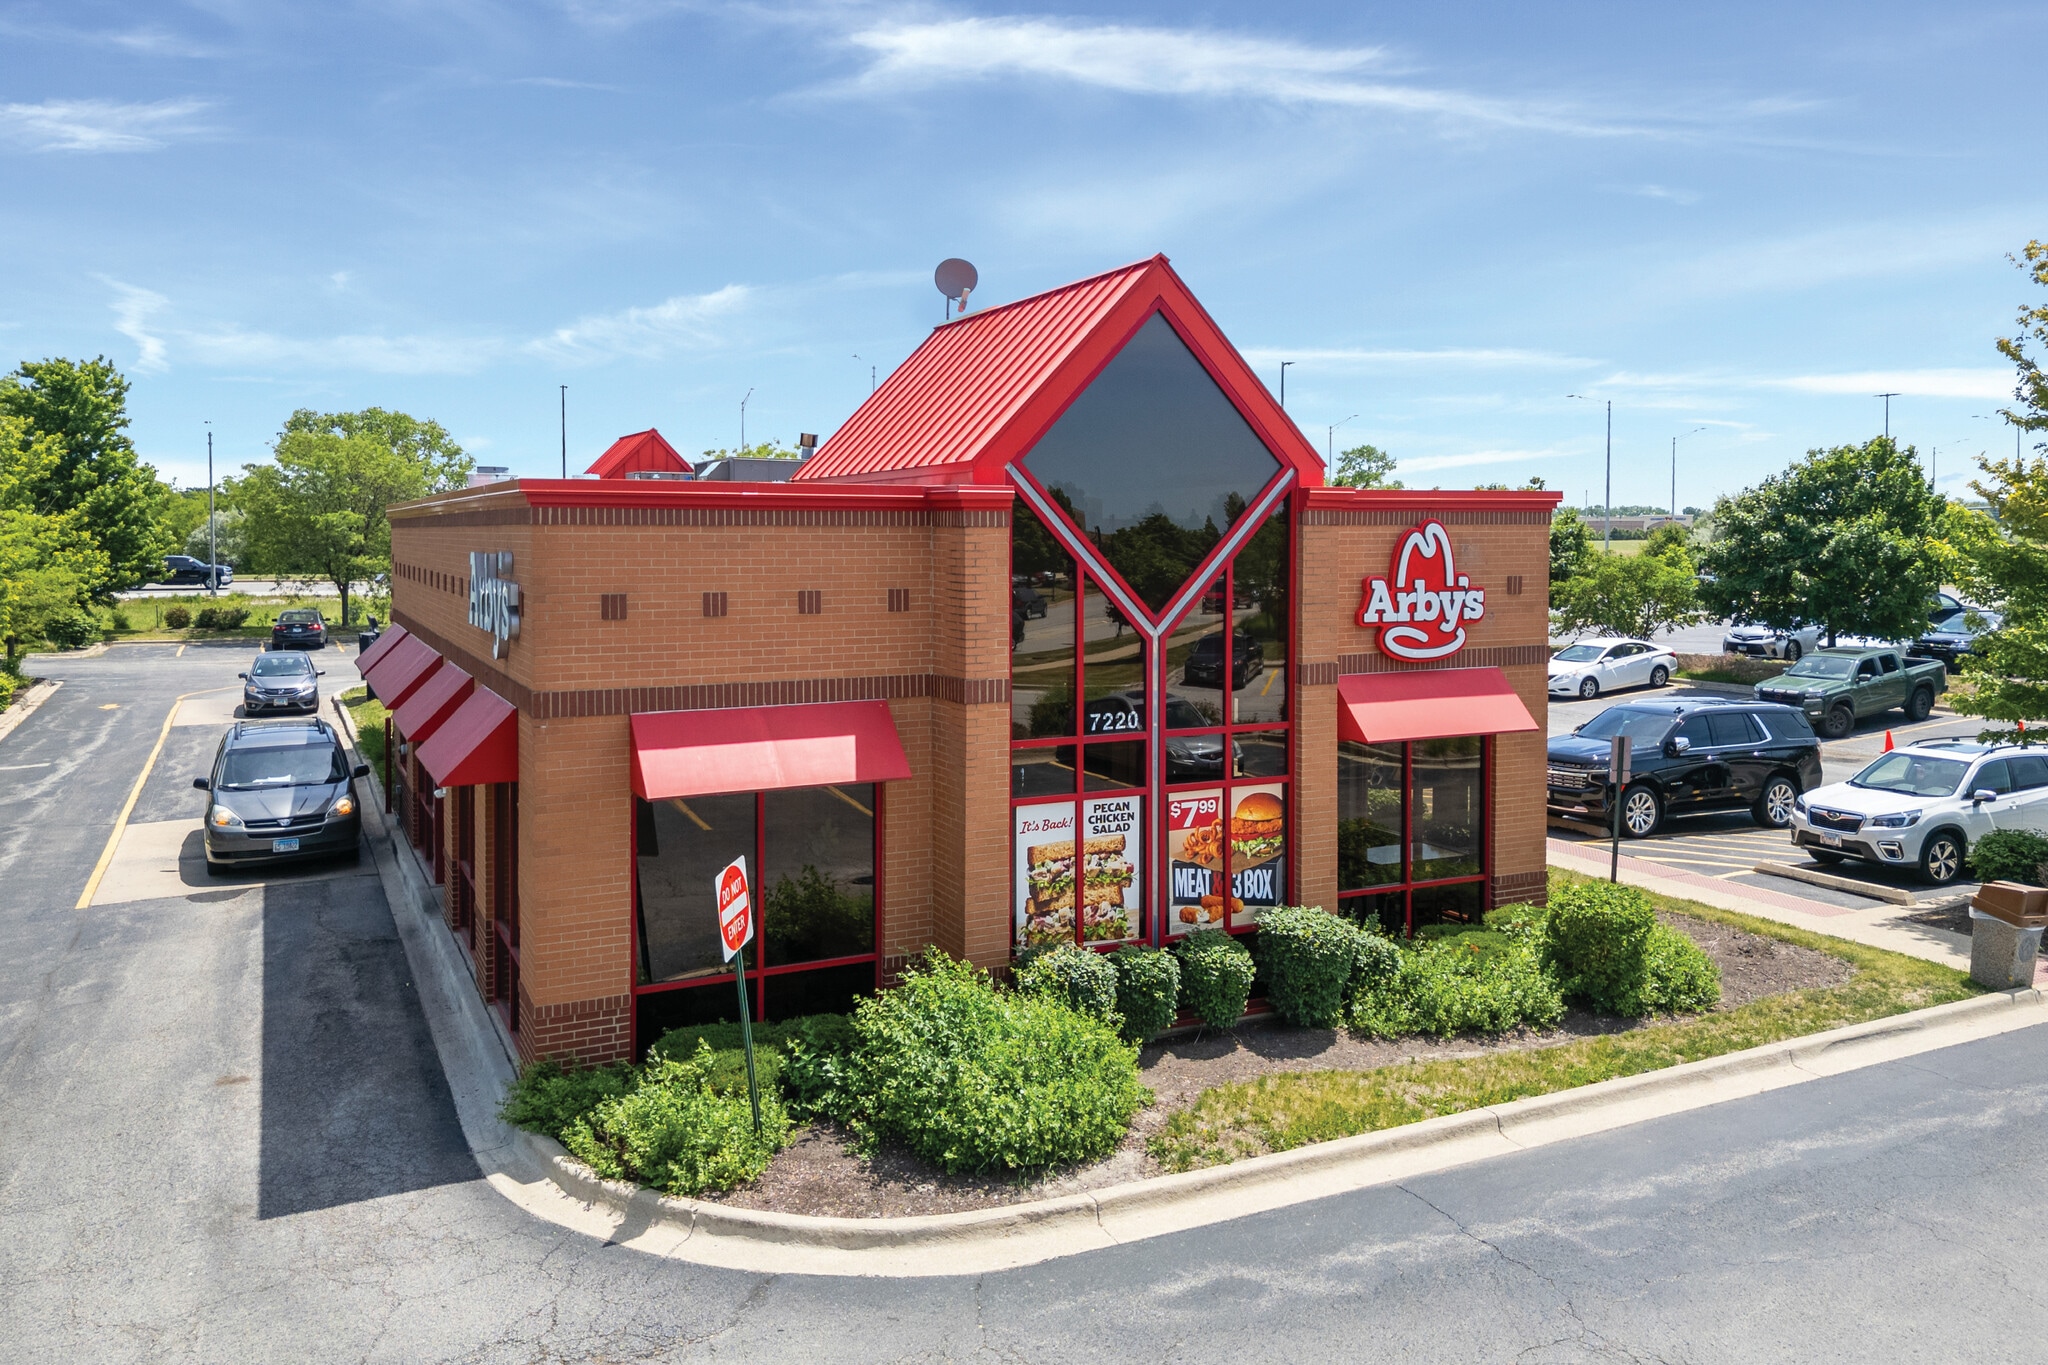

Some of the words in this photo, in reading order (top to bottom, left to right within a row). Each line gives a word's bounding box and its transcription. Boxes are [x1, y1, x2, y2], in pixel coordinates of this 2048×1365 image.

[468, 551, 511, 660] Arby's
[1363, 576, 1485, 633] Arby's
[1090, 711, 1139, 731] 7220
[1088, 812, 1135, 825] CHICKEN
[1093, 801, 1130, 814] PECAN
[1019, 820, 1040, 835] It's
[1041, 817, 1074, 832] Back!
[1092, 823, 1131, 835] SALAD
[722, 887, 730, 905] DO
[731, 876, 742, 896] NOT
[1174, 868, 1212, 898] MEAT
[1232, 873, 1242, 898] 3
[1244, 868, 1274, 900] BOX
[728, 915, 746, 940] ENTER
